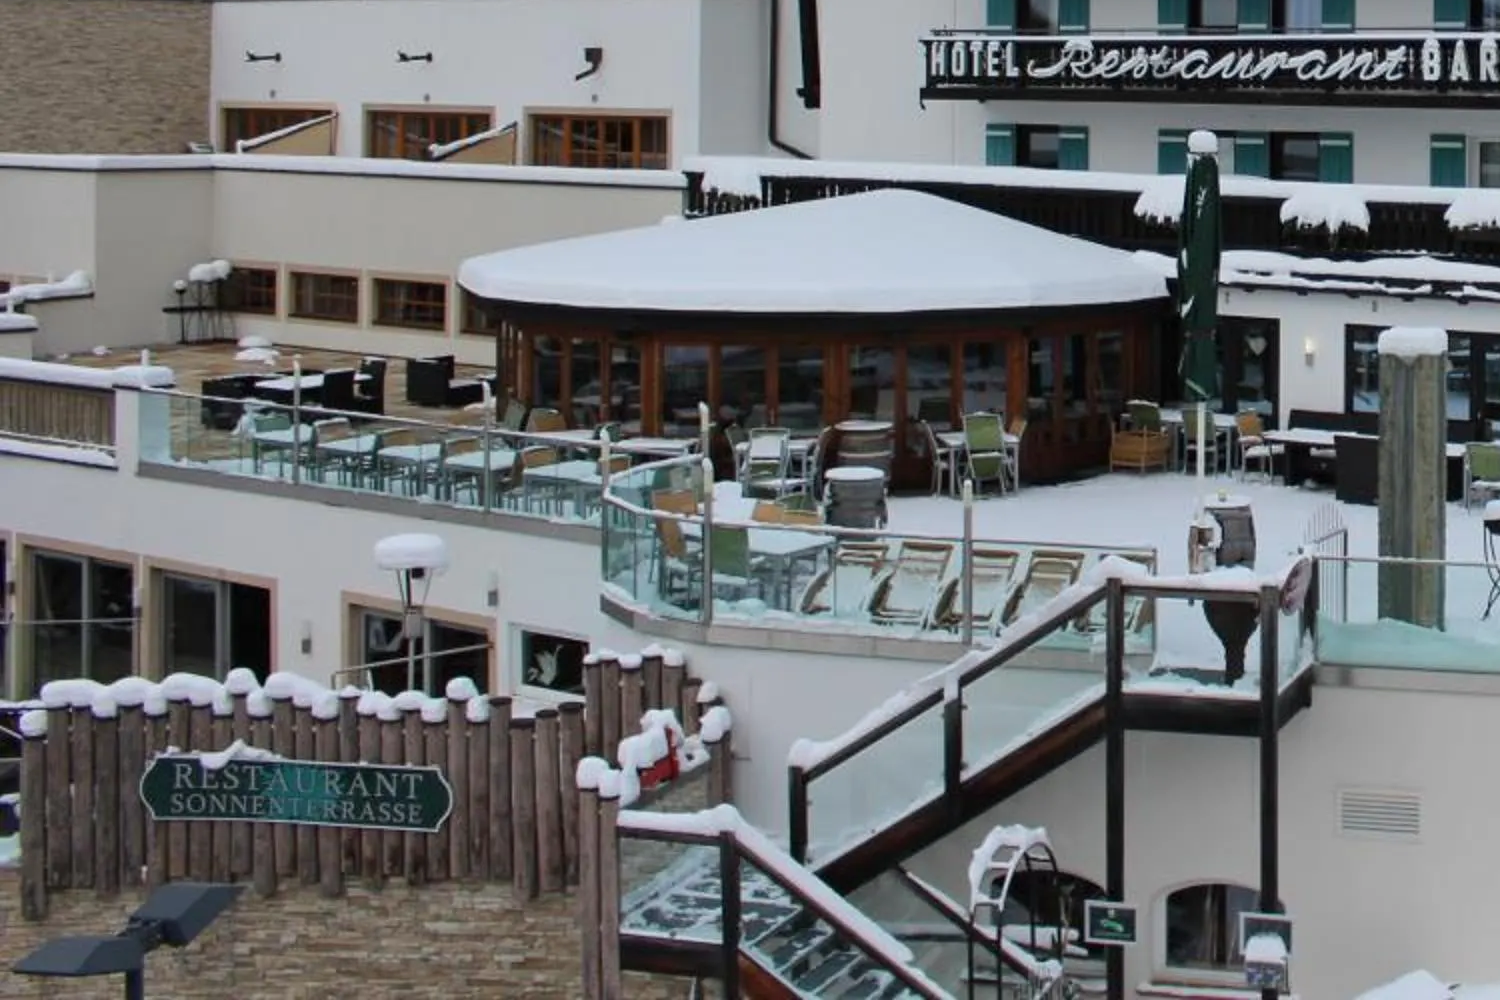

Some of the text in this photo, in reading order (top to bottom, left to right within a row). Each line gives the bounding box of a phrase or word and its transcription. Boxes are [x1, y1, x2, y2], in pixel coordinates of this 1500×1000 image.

[930, 37, 1500, 82] HOTEL Restaurant BAR
[174, 763, 423, 799] RESTAURANT
[170, 793, 423, 823] SONNENTERRASSE
